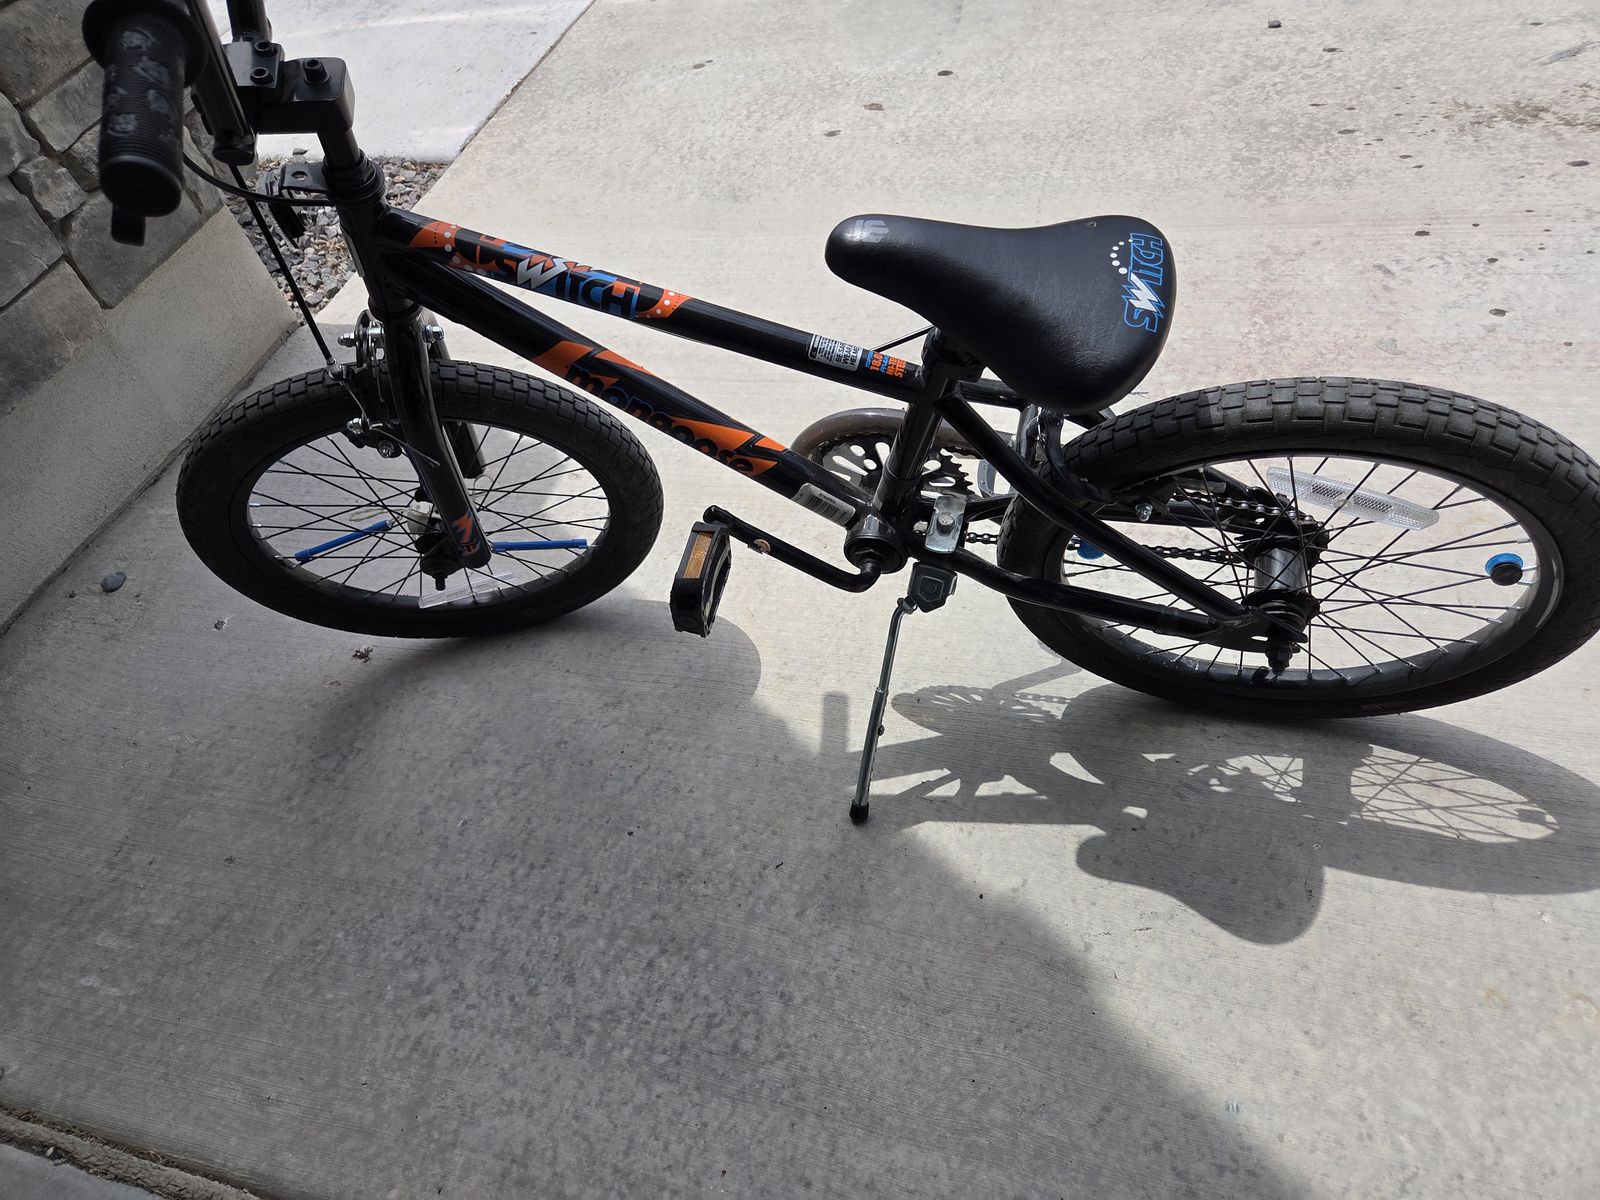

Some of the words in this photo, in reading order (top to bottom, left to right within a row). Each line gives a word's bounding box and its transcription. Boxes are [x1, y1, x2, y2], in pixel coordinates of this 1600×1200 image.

[490, 256, 641, 320] SWITCH
[1121, 232, 1166, 333] SWITCH
[836, 351, 844, 363] BE
[849, 345, 861, 366] HELME
[894, 359, 907, 378] STEE
[566, 363, 755, 477] mongoose
